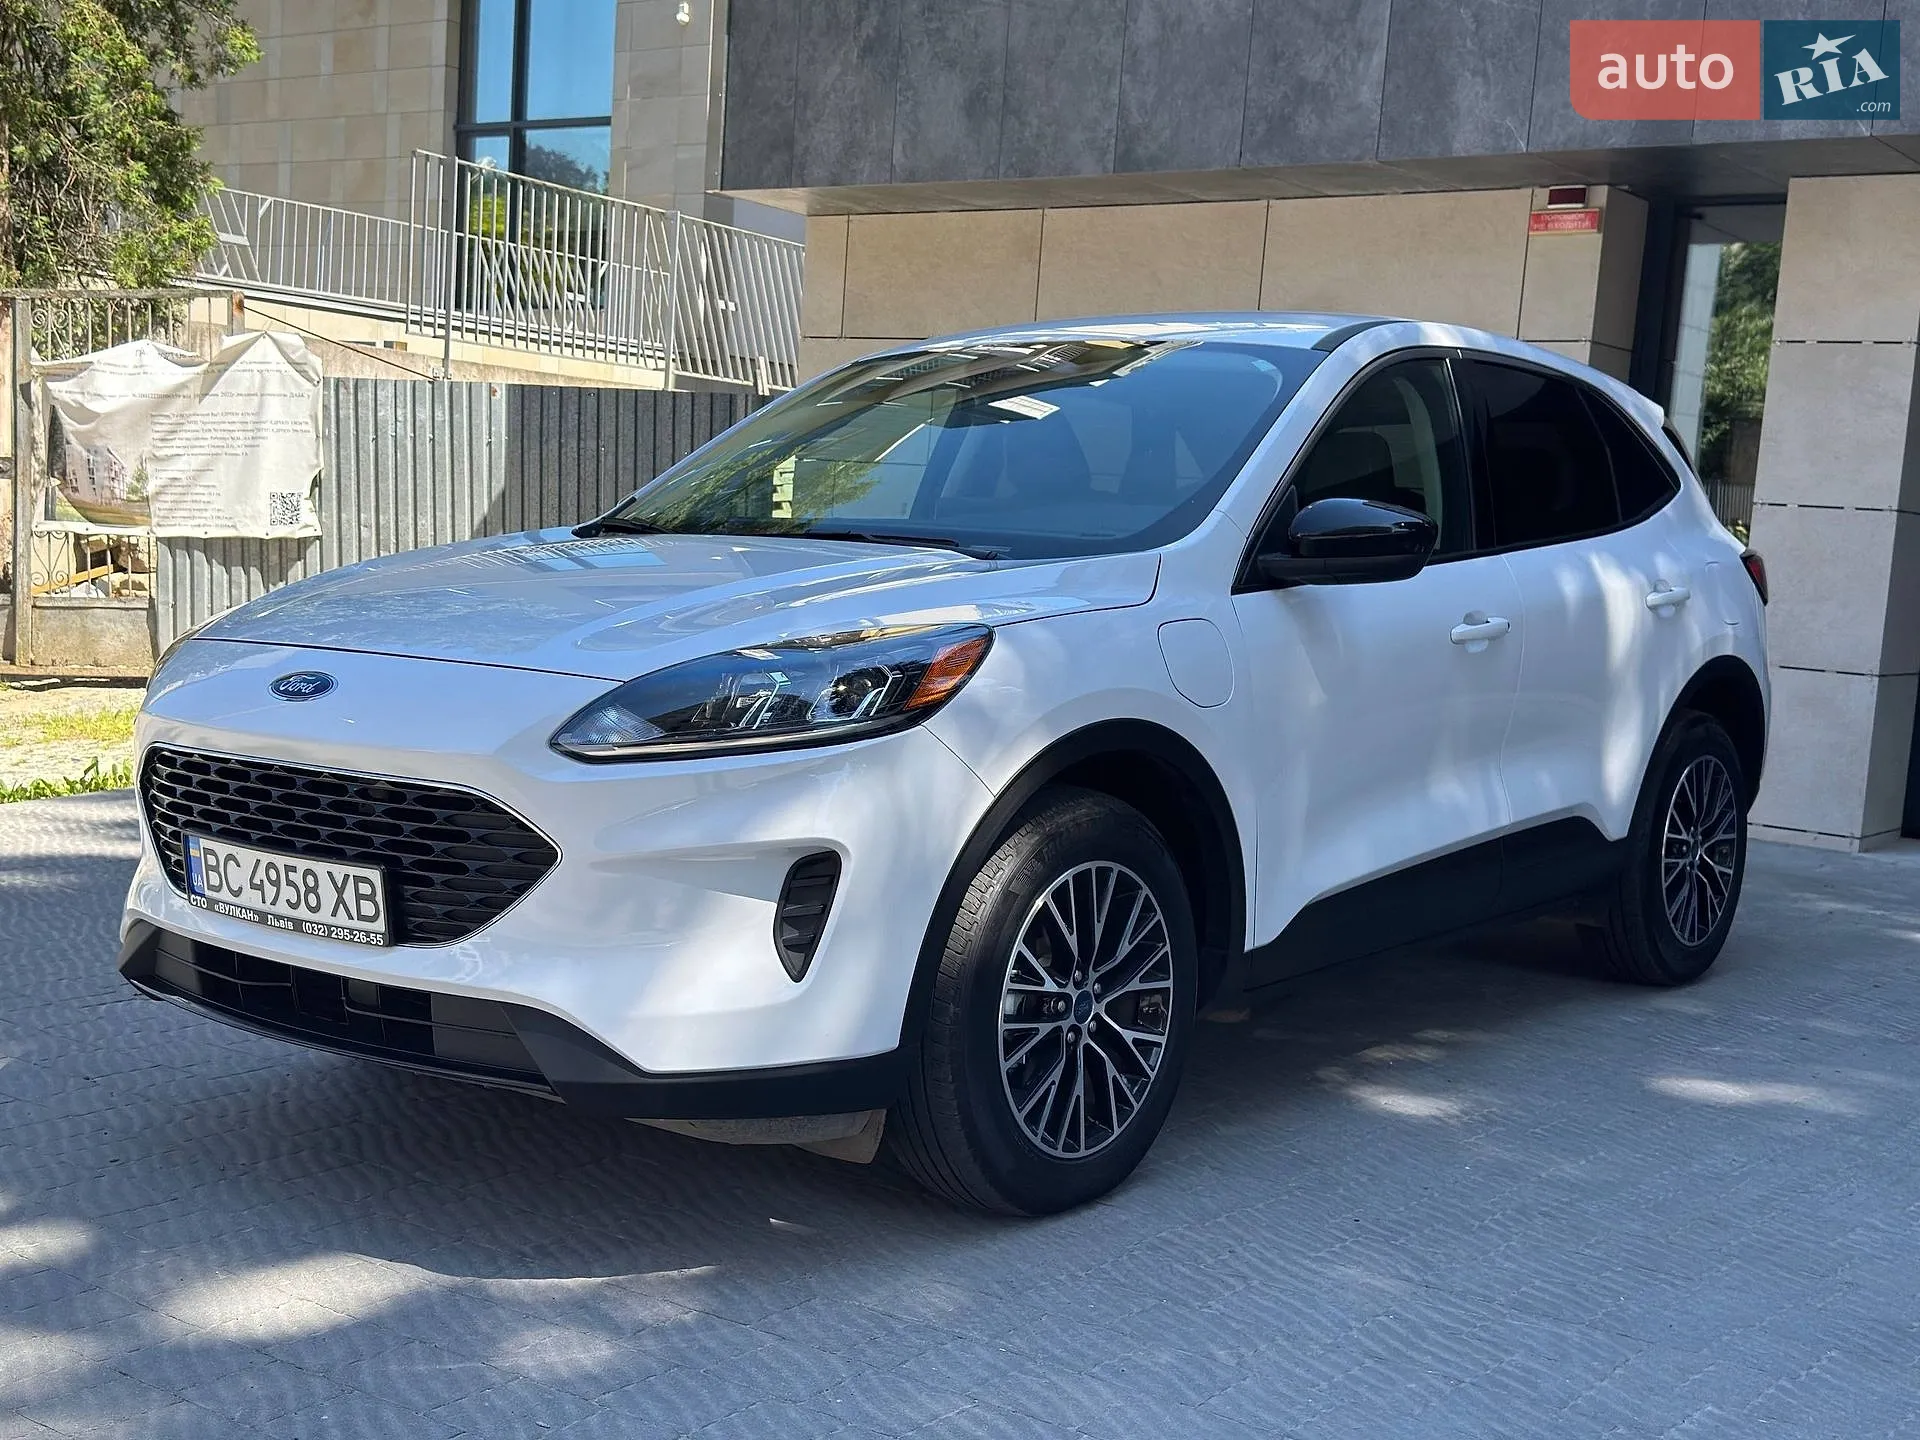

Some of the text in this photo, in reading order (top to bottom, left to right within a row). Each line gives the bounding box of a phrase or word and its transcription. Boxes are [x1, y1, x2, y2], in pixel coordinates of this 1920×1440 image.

[279, 675, 321, 693] Ford
[192, 872, 204, 887] UA
[202, 847, 381, 923] BC 4958 XB
[190, 894, 208, 909] СТО
[267, 914, 294, 930] Львів
[302, 921, 328, 937] (032)
[331, 927, 384, 946] 295-26-55
